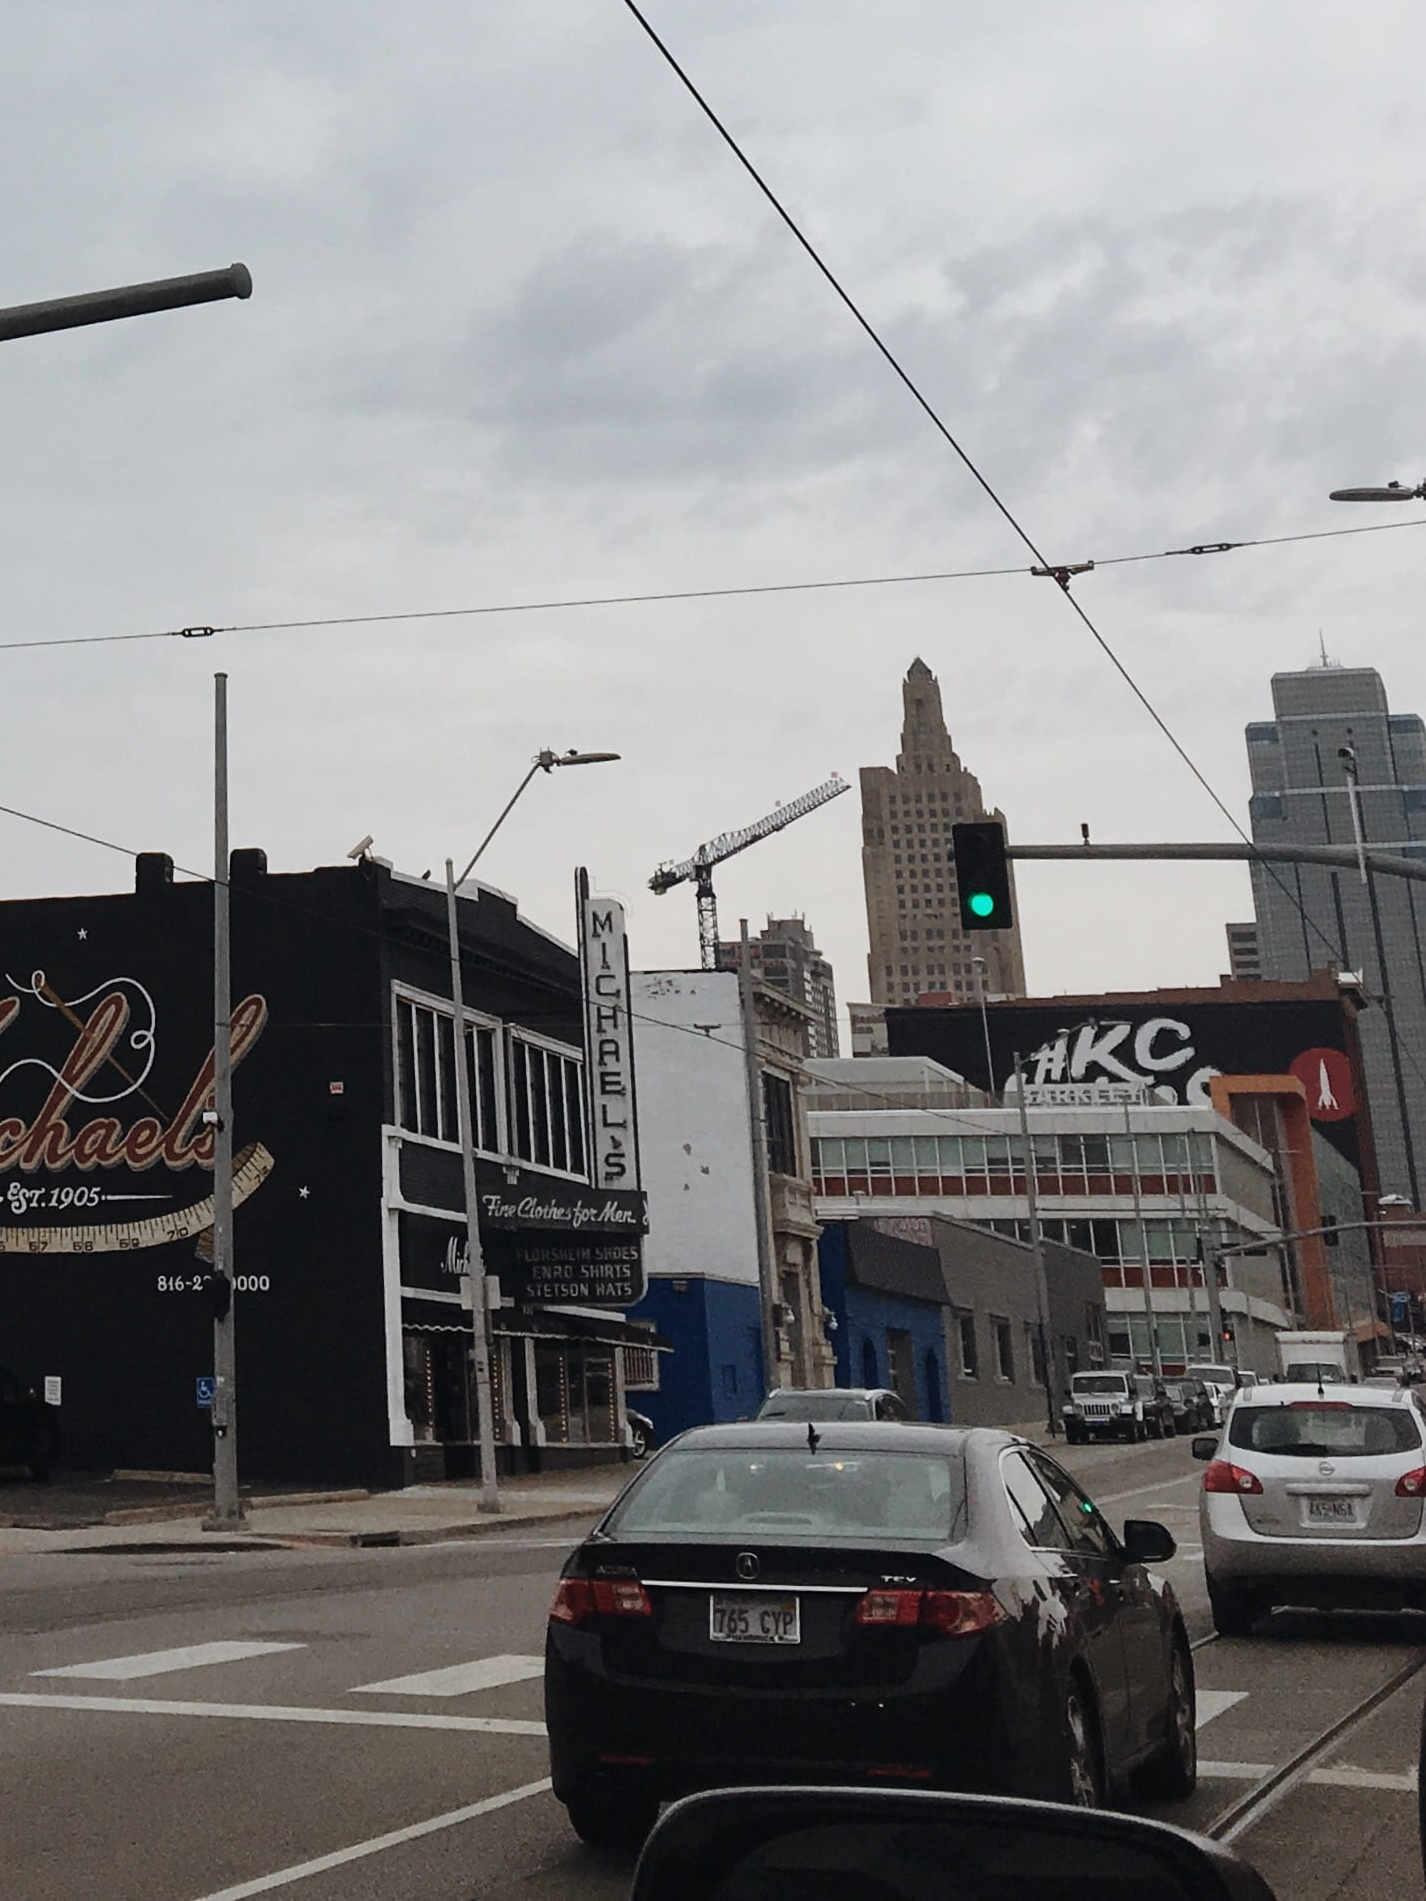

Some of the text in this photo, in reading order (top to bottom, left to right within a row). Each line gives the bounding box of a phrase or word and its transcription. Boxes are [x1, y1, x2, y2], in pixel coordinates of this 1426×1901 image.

[482, 1195, 637, 1227] Fine Clothes for Men
[516, 1246, 639, 1263] FLORSHEIM SHOES
[580, 1264, 631, 1279] SHIRTS
[157, 1275, 270, 1291] 816-2000
[526, 1282, 633, 1298] STETSON HATS
[715, 1608, 793, 1635] 765 CYP
